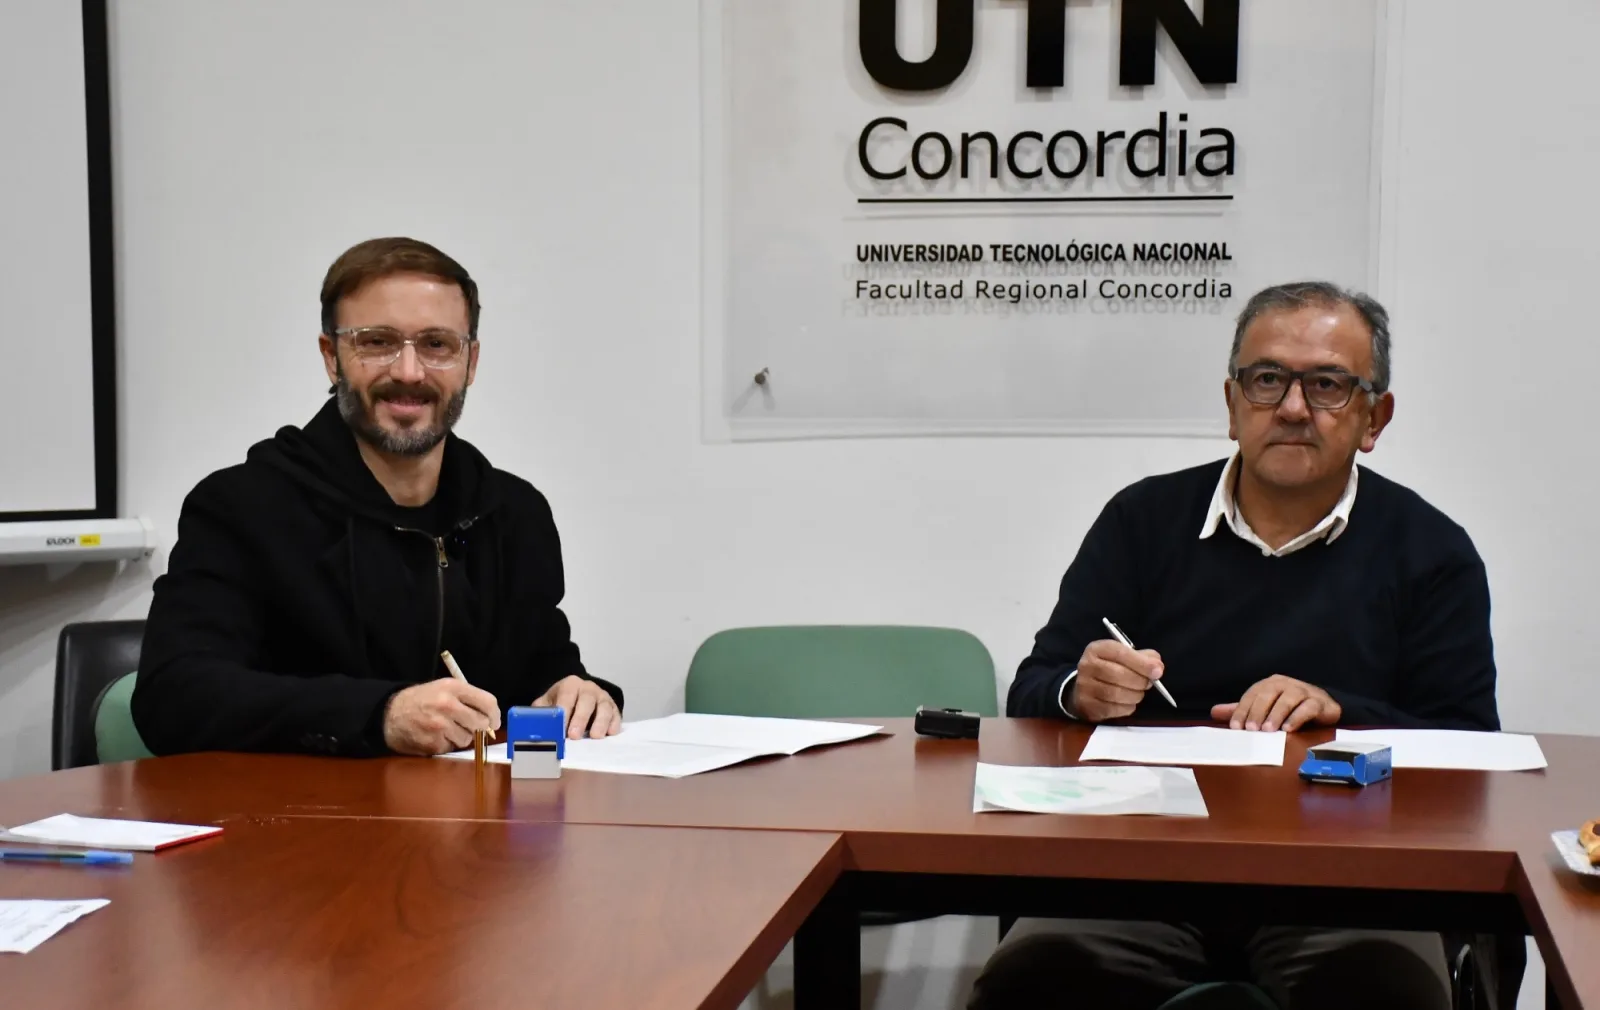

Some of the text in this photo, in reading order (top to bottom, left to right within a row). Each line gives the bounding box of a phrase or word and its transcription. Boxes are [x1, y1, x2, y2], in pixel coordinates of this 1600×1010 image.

[859, 0, 1240, 91] UTN
[858, 111, 1235, 180] Concordia
[857, 240, 1232, 263] UNIVERSIDAD TECNOLÓGICA NACIONAL
[856, 278, 1232, 304] Facultad Regional Concordia
